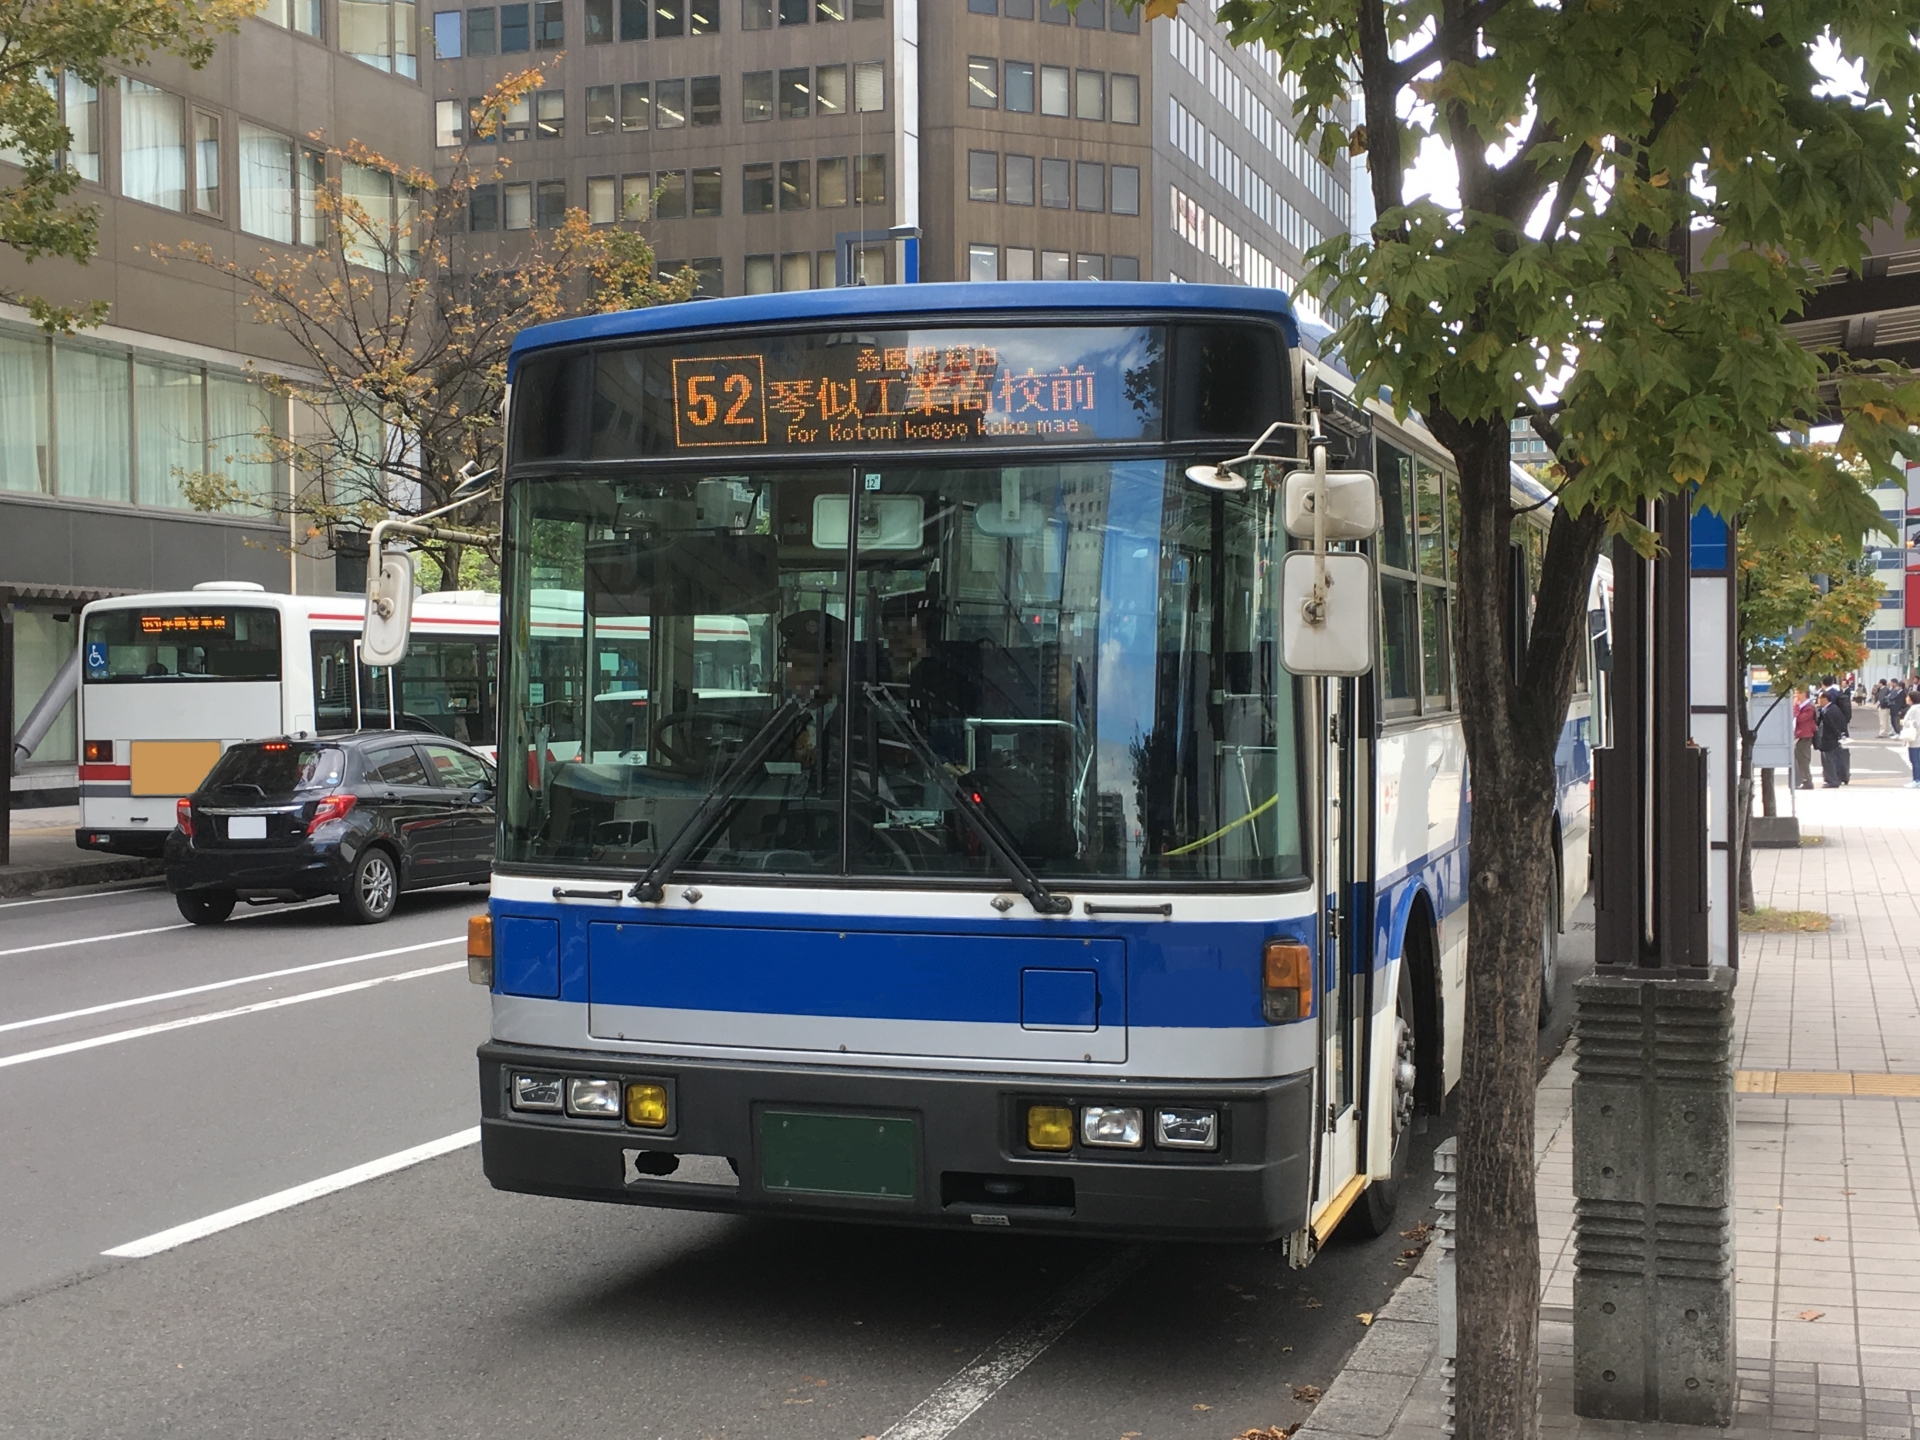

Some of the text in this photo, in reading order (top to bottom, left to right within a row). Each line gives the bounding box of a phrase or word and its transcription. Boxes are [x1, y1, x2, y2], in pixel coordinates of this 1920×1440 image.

[687, 374, 754, 426] 52
[768, 365, 1094, 421] 琴似工業高校前
[787, 417, 1079, 443] For Kotoni kogyo koko mae
